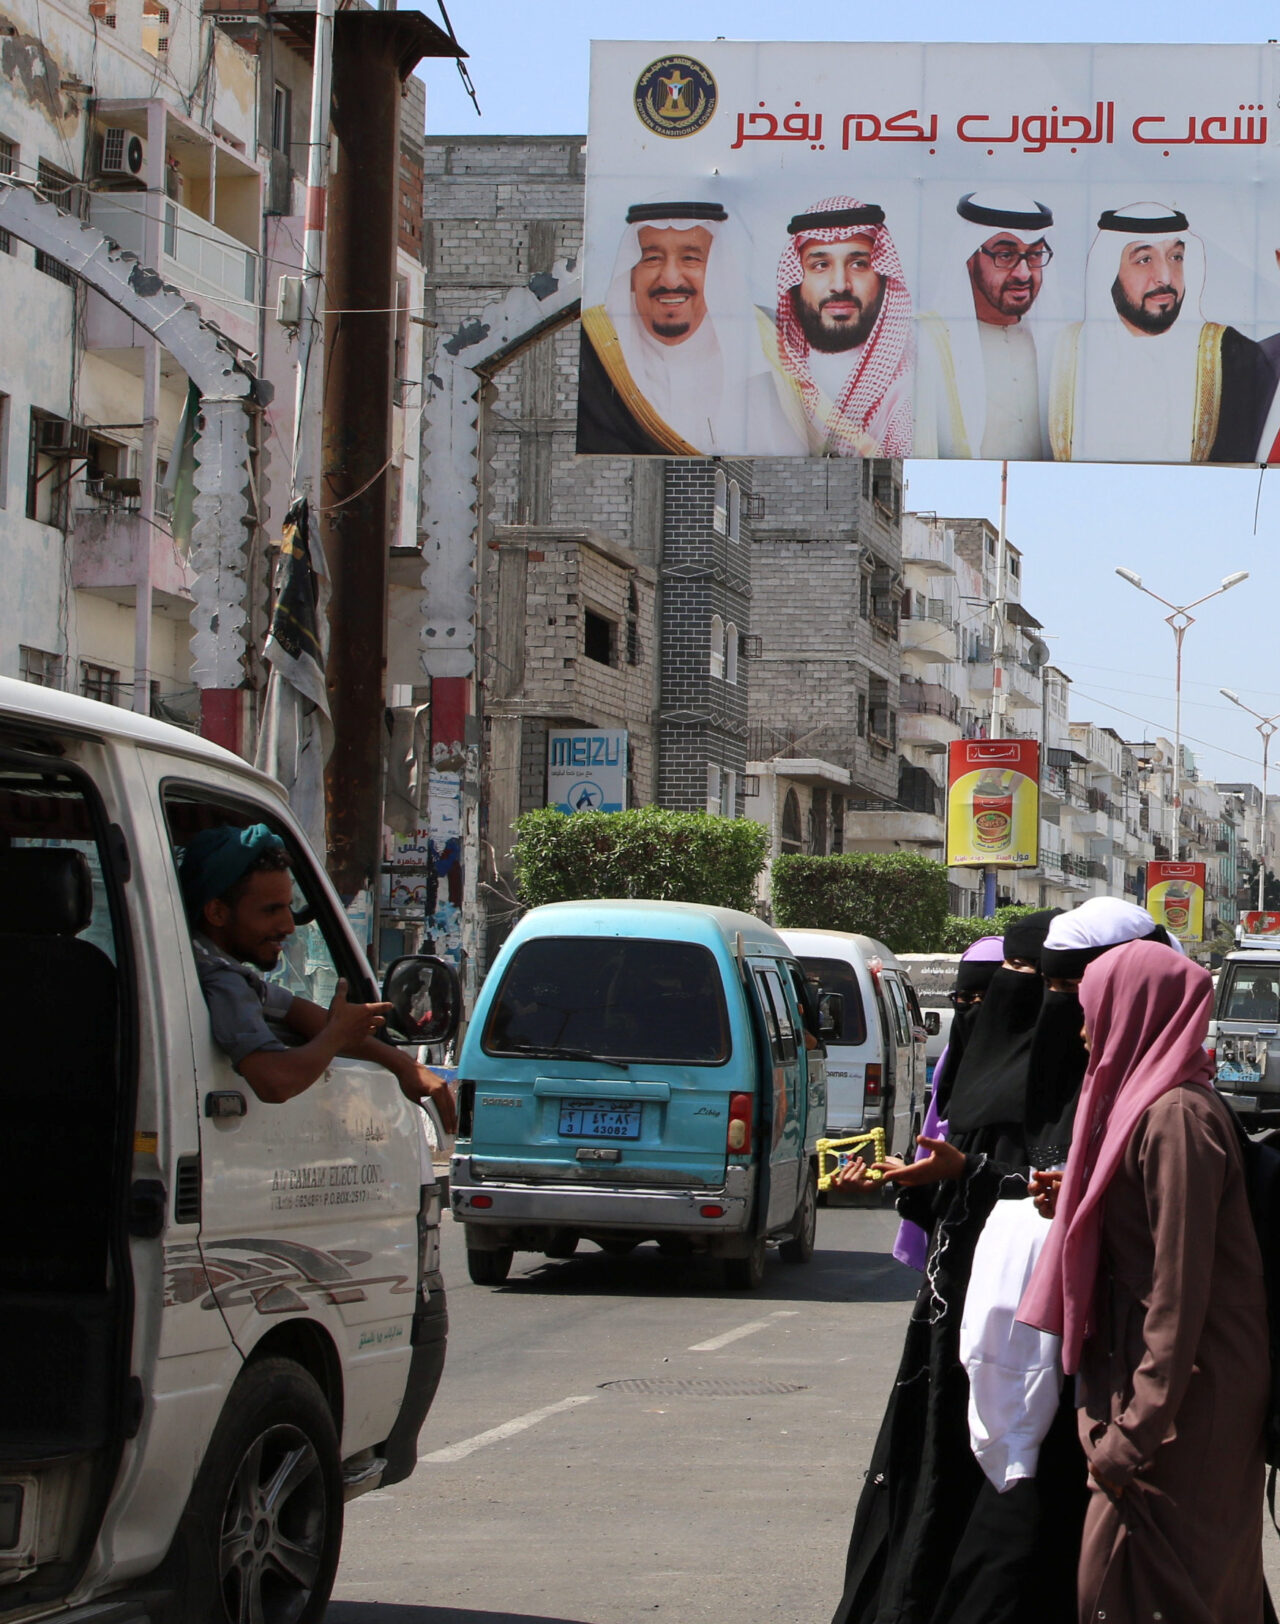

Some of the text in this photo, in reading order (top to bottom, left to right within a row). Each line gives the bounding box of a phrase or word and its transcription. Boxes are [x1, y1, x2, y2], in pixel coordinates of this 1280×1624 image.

[636, 98, 715, 136] SOUTHERN TRANSITIONAL COUNCIL
[730, 101, 1268, 157] شعب الجنوب بكم يفخر
[551, 736, 620, 767] MEIZU
[566, 1124, 574, 1133] 3
[593, 1125, 628, 1136] 43082
